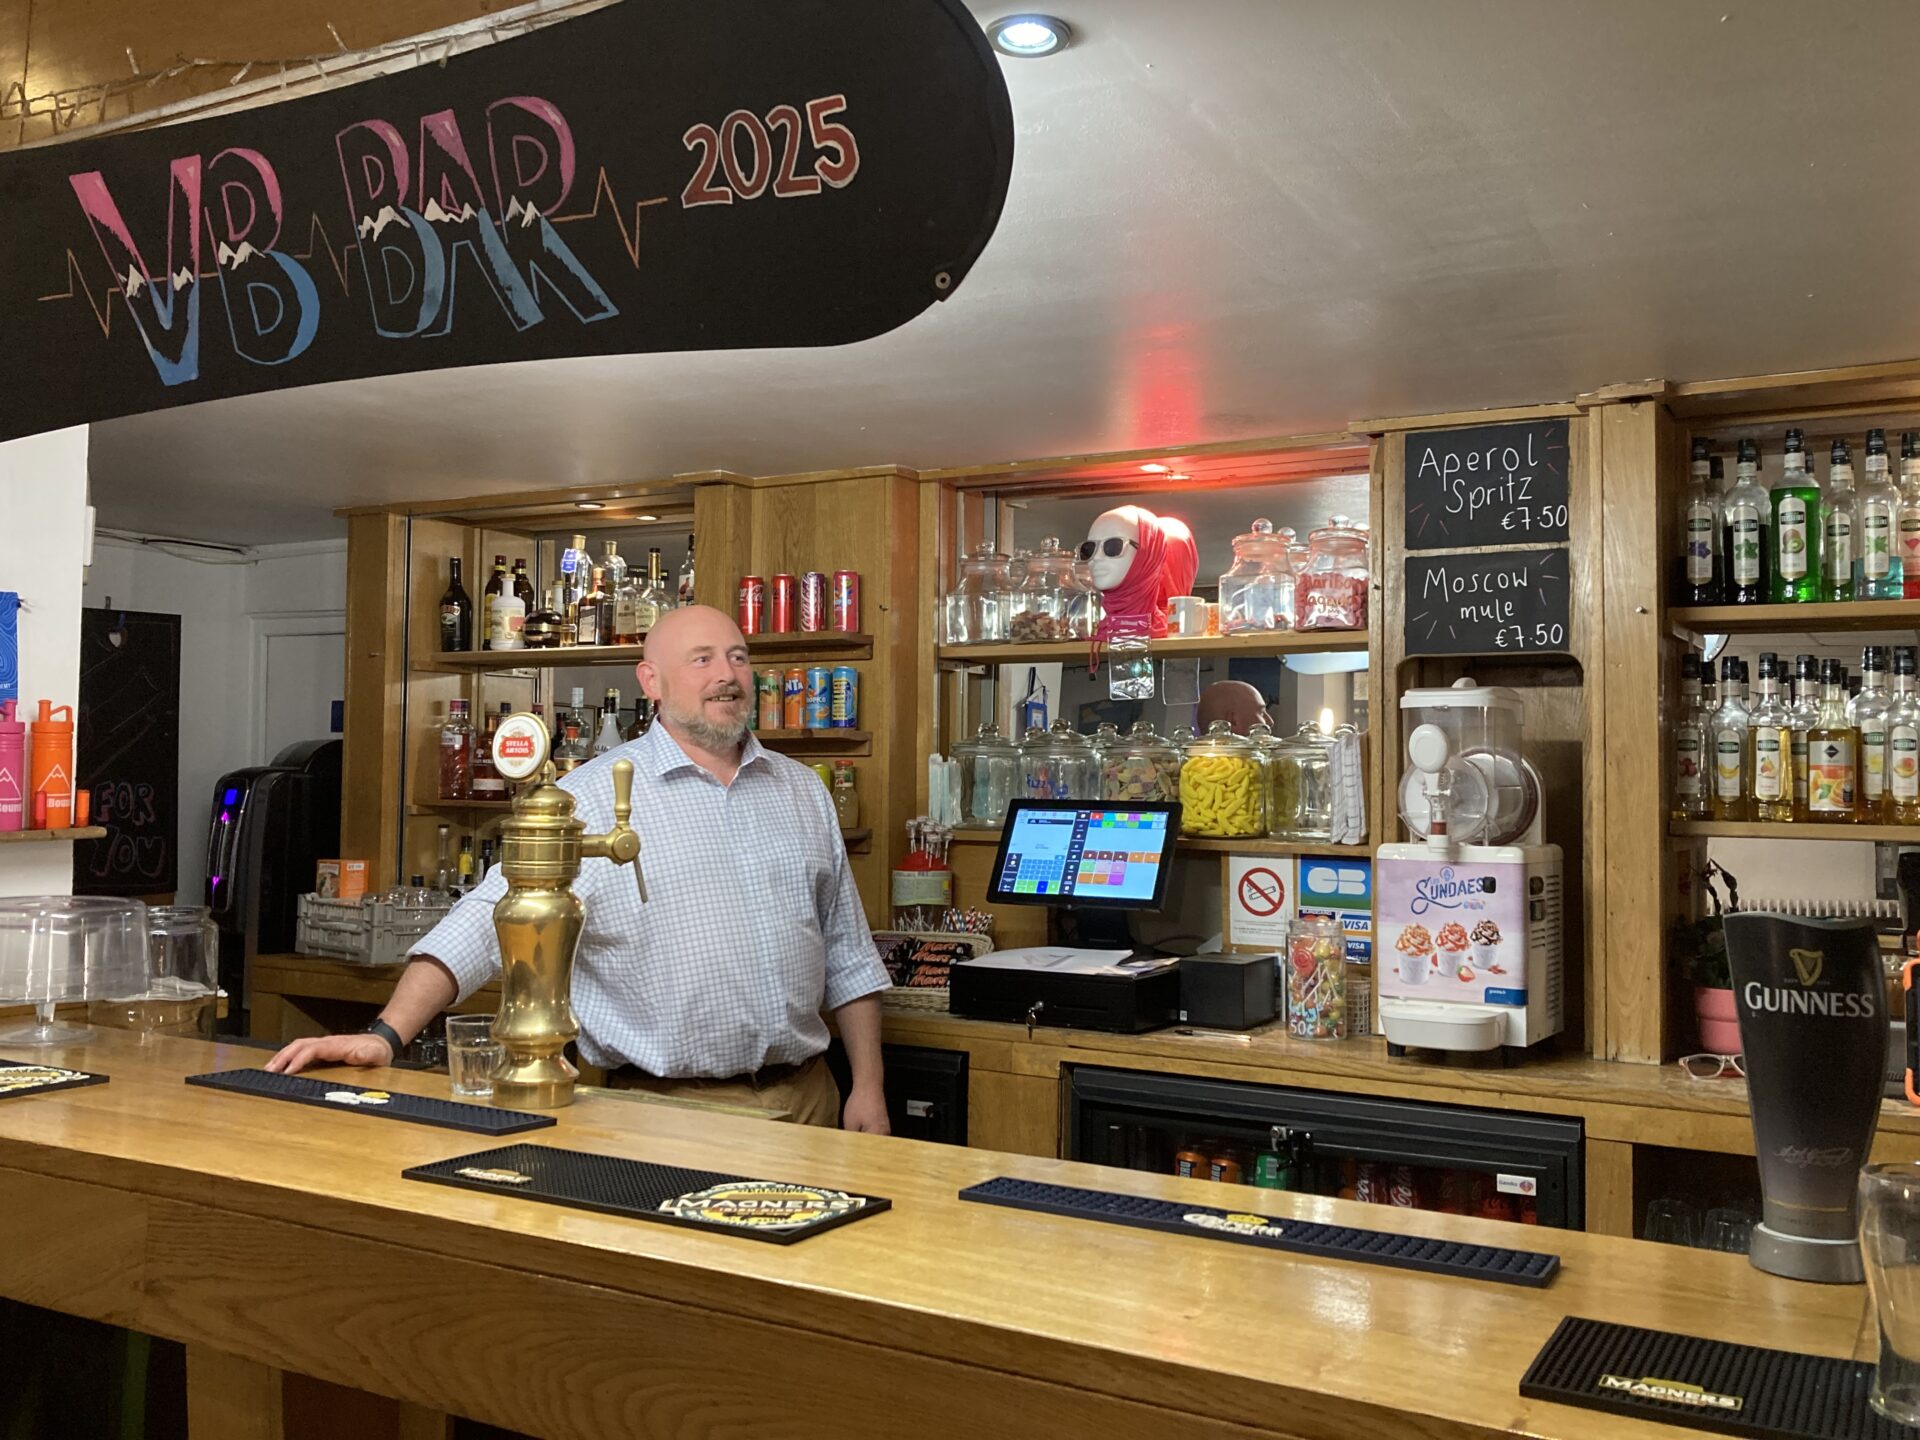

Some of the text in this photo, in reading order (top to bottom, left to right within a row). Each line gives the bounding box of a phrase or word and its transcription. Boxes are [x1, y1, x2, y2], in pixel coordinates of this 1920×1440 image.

[681, 94, 860, 208] 2025
[69, 96, 620, 387] VB BAR
[1418, 433, 1538, 492] Aperol
[1445, 473, 1533, 521] Spritz
[1500, 504, 1568, 531] €7.50
[1423, 567, 1528, 603] Moscow
[1460, 598, 1515, 623] mule
[1494, 623, 1564, 648] €7.50
[93, 781, 156, 826] FOR
[1411, 876, 1486, 915] SUNDAES
[1344, 920, 1369, 931] VISA
[911, 951, 950, 962] Mars
[1347, 942, 1366, 950] VISA
[1744, 981, 1875, 1018] GUINNESS
[677, 1198, 856, 1210] MAGNERS
[1605, 1376, 1736, 1407] MAGNERS
